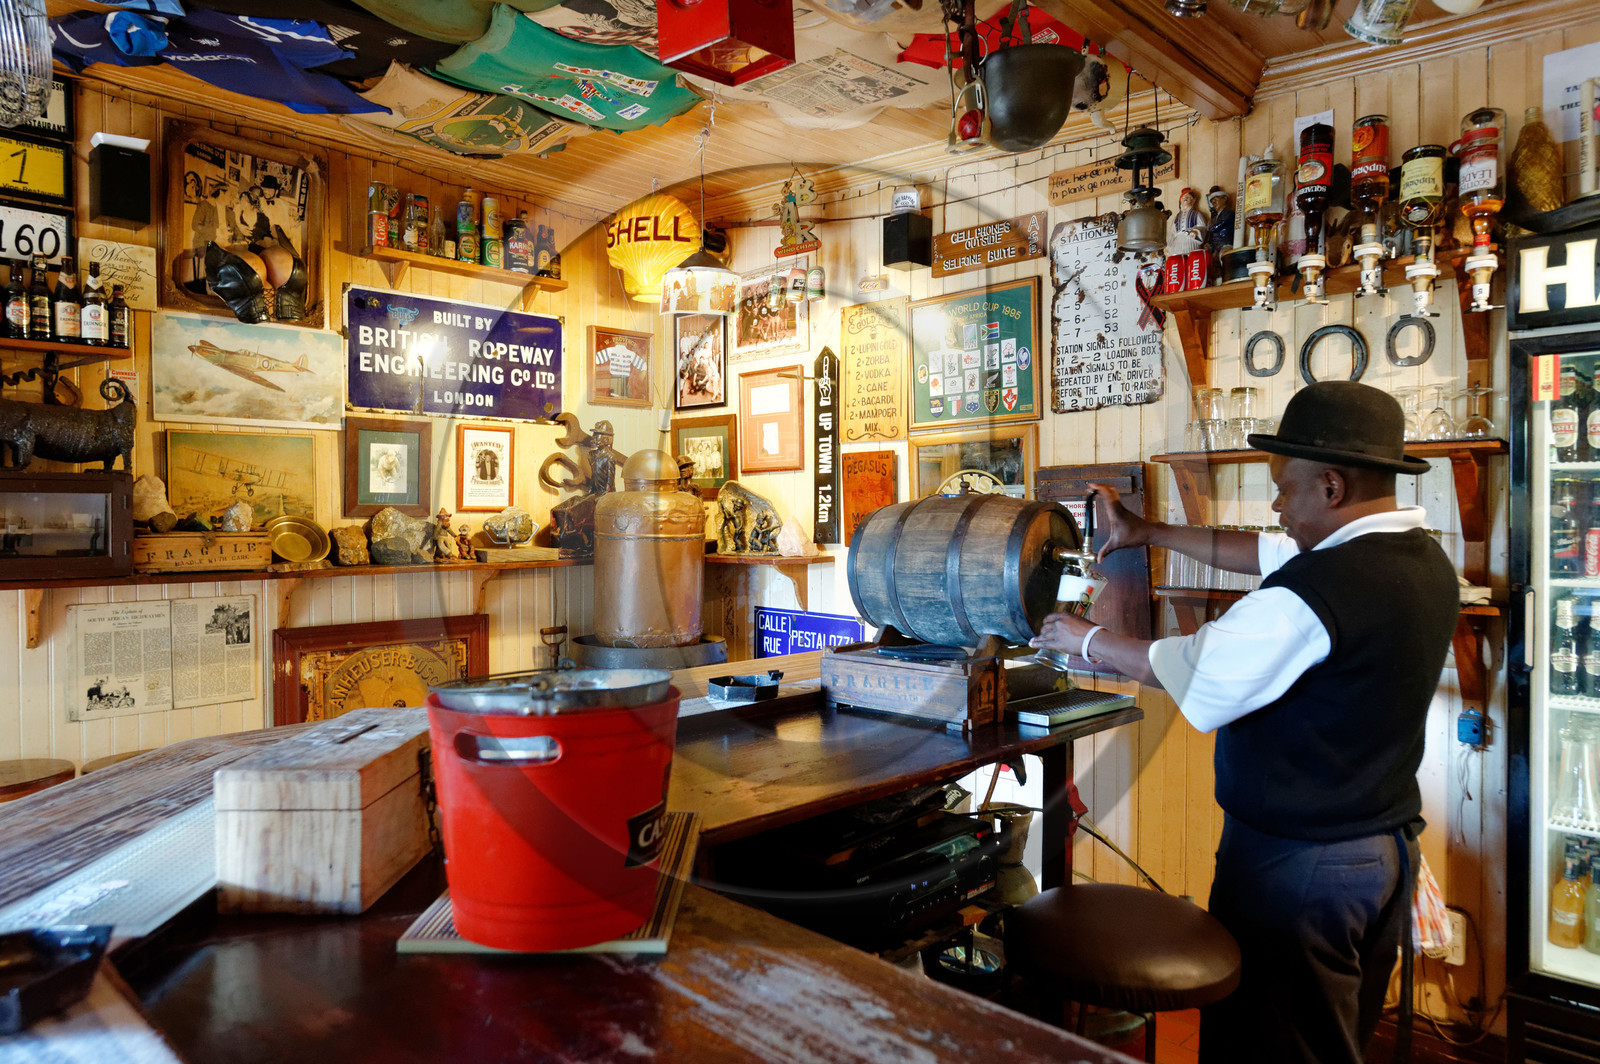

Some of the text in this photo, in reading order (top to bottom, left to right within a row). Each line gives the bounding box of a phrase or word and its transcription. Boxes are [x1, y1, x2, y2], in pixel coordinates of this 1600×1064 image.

[162, 53, 257, 64] vodacom
[16, 139, 34, 149] Rest
[1062, 185, 1085, 199] plank
[607, 216, 691, 248] SHELL
[951, 221, 1011, 245] CELL PHONES
[1060, 229, 1102, 245] STATION
[965, 233, 1003, 250] OUTSIDE
[943, 246, 1016, 271] SELFONE BUITE
[1074, 260, 1081, 269] 2
[101, 267, 142, 281] Friends
[1104, 267, 1119, 277] 49
[1169, 263, 1179, 285] John
[1191, 259, 1200, 281] John
[1519, 239, 1600, 313] H
[1104, 281, 1119, 291] 50
[1074, 295, 1117, 310] 5 51
[949, 302, 1021, 320] WORLD CUP 1995
[1074, 309, 1119, 324] 6 52
[433, 311, 493, 331] BUILT BY
[856, 316, 876, 330] GOLD
[1074, 323, 1119, 338] 7 53
[358, 325, 554, 367] BRITISH ROPEWAY
[859, 343, 878, 354] LUPINI
[879, 340, 897, 350] GOLD
[1057, 334, 1157, 355] STATION SIGNALS FOLLOWED
[865, 356, 890, 366] ZORBA
[1057, 357, 1066, 366] BY
[1071, 356, 1079, 364] 2
[1093, 352, 1101, 361] 2
[1106, 348, 1138, 360] LOADING
[359, 352, 505, 385] ENGINEERING
[865, 368, 891, 380] VODKA
[1086, 362, 1115, 373] SIGNALS
[1119, 360, 1128, 369] TO
[1132, 359, 1141, 368] BE
[1094, 374, 1104, 383] BY
[1127, 368, 1154, 380] DRIVER
[867, 382, 888, 391] CANE
[1085, 386, 1098, 395] THE
[1107, 384, 1113, 393] 1
[1121, 383, 1131, 392] TO
[433, 390, 494, 407] LONDON
[861, 394, 894, 406] BACARDI
[1085, 397, 1095, 407] TO
[1125, 394, 1132, 403] IS
[859, 408, 897, 420] MAMPOER
[818, 412, 832, 523] UP TOWN 1.2km
[847, 459, 887, 479] PEGASUS
[146, 543, 256, 562] FRAGILE
[758, 613, 787, 633] CALLE
[763, 636, 782, 655] RUE
[329, 649, 439, 710] ANHEUSER-BUSC
[830, 673, 935, 691] FRAGILE
[638, 816, 664, 847] CA
